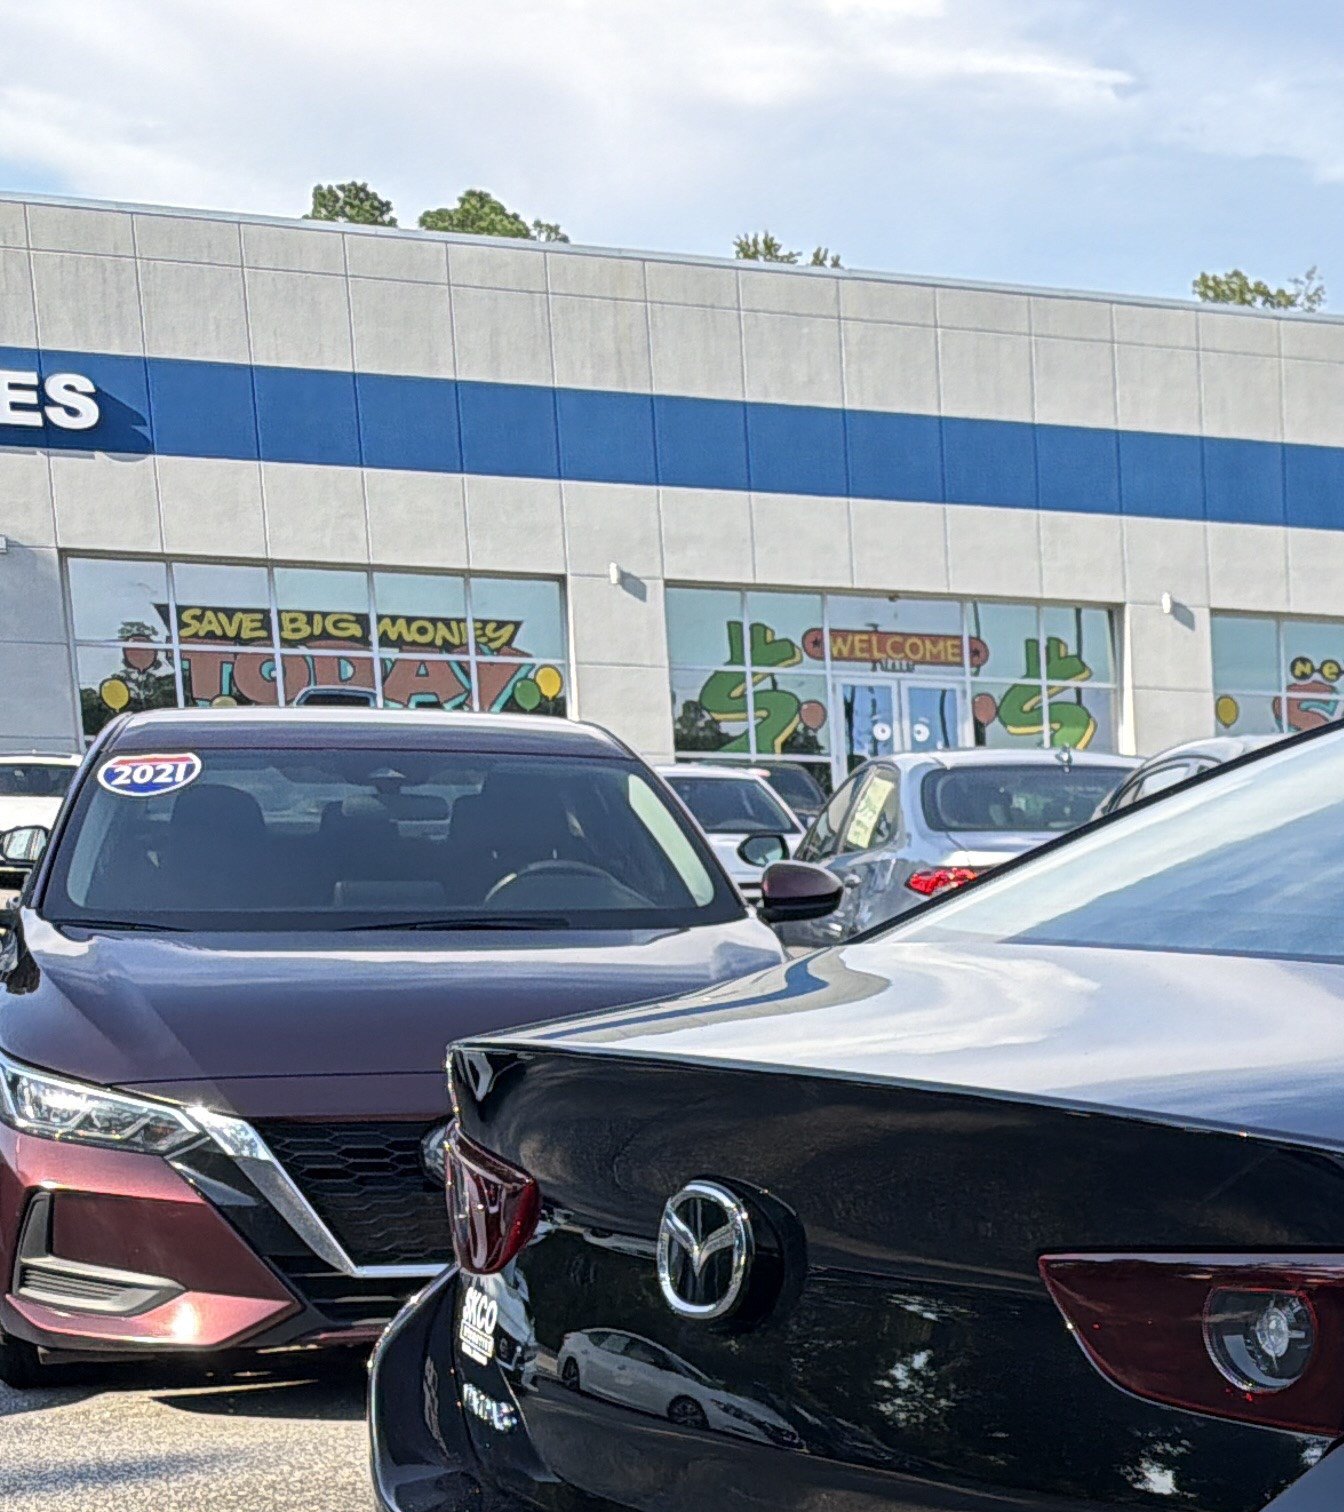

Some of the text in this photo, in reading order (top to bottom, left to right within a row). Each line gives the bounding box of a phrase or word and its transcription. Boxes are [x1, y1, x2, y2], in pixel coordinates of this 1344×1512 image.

[178, 607, 516, 648] SAVE BIG MONEY
[830, 632, 963, 662] WELCOME
[180, 637, 533, 711] TODAY
[111, 763, 188, 785] 2021
